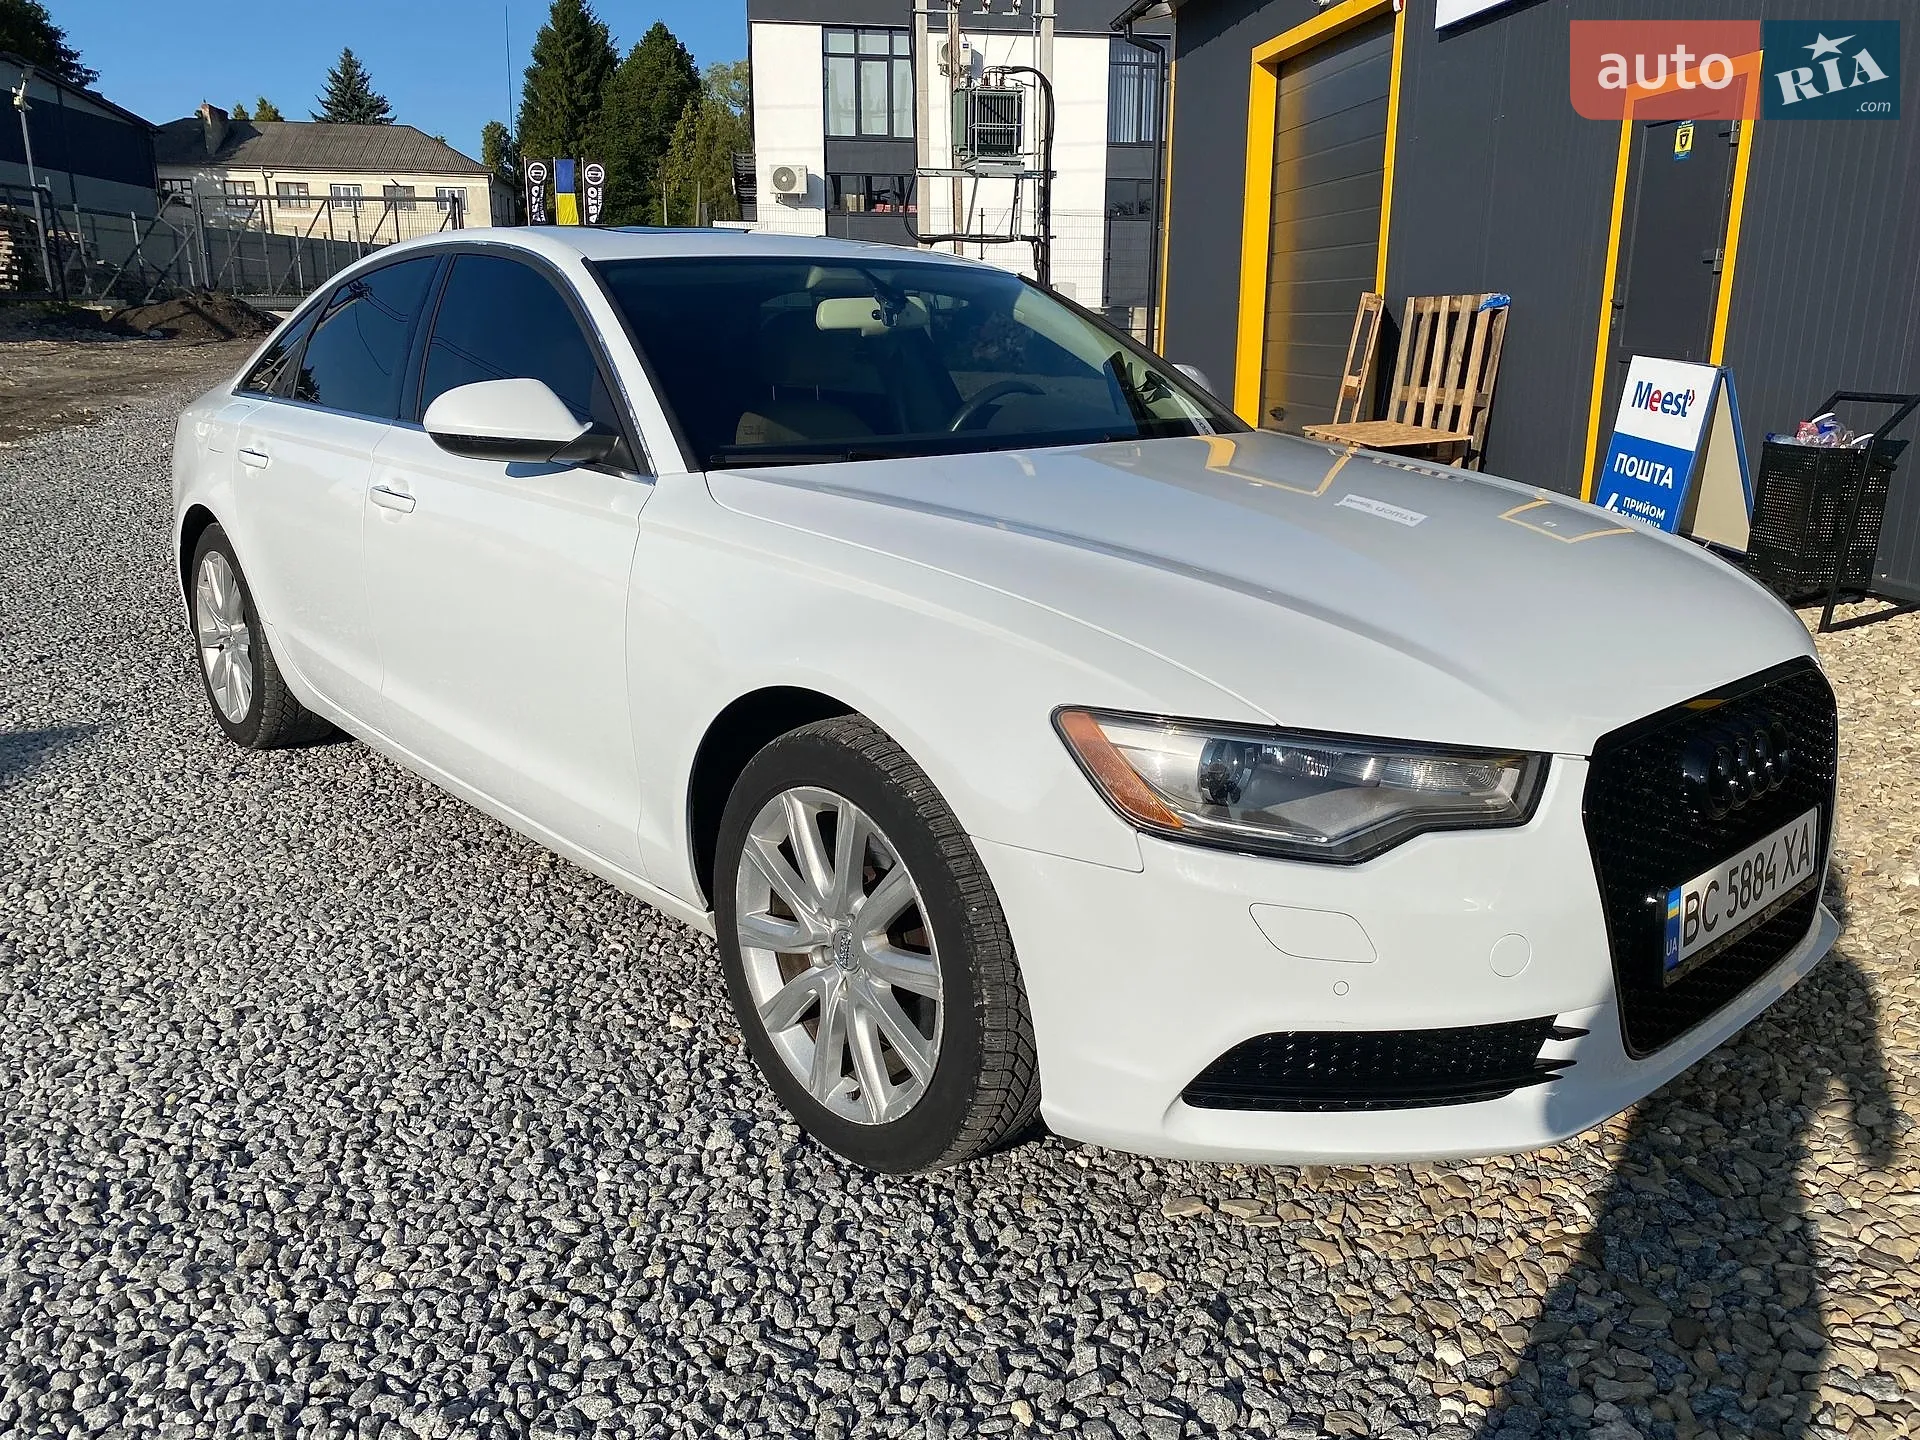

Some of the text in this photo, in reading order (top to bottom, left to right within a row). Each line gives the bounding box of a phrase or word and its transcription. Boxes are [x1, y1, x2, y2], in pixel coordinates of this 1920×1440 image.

[587, 187, 598, 223] АВТО
[1631, 381, 1691, 417] Meest
[1614, 452, 1673, 489] ПОШТА
[1623, 496, 1666, 521] ПРИЙОМ
[1683, 822, 1810, 947] BC 5884 XA
[1666, 937, 1678, 956] UA
